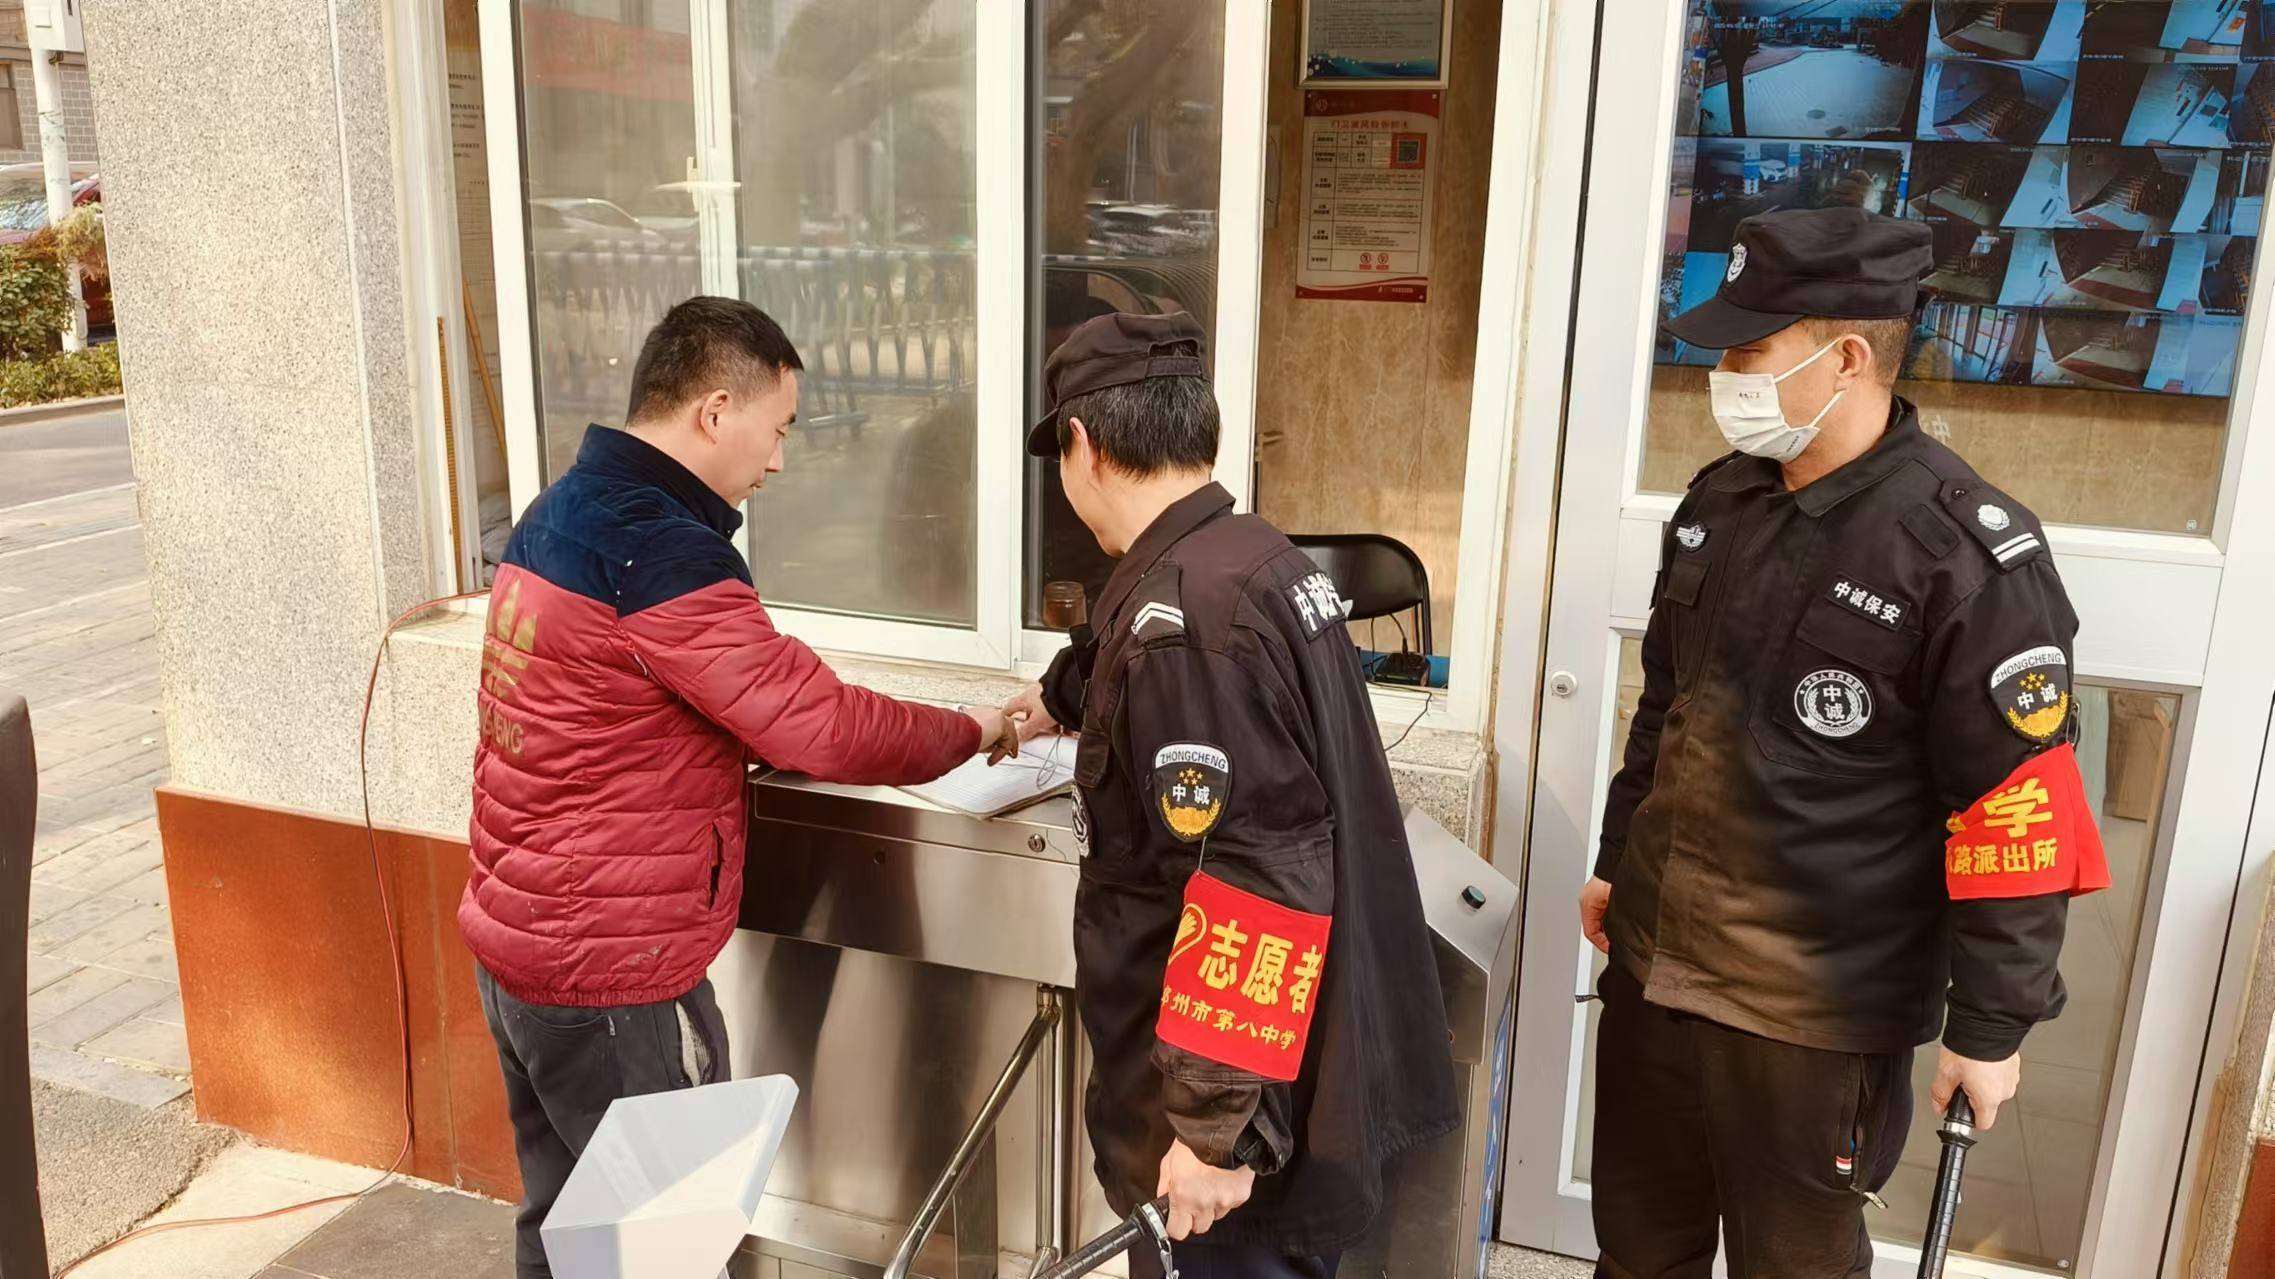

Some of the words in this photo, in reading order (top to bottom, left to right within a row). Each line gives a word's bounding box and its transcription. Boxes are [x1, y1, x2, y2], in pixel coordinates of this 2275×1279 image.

[1834, 581, 1901, 624] 中诚保安
[1995, 653, 2062, 682] ZHONGCHENG
[1823, 684, 1846, 720] 中诚
[2017, 683, 2058, 710] 中诚
[1160, 751, 1227, 770] ZHONGCHENG
[1172, 783, 1211, 805] 中诚
[1946, 777, 2053, 839] 学
[1947, 838, 2058, 876] 路派出所
[1197, 919, 1323, 1014] 志愿者
